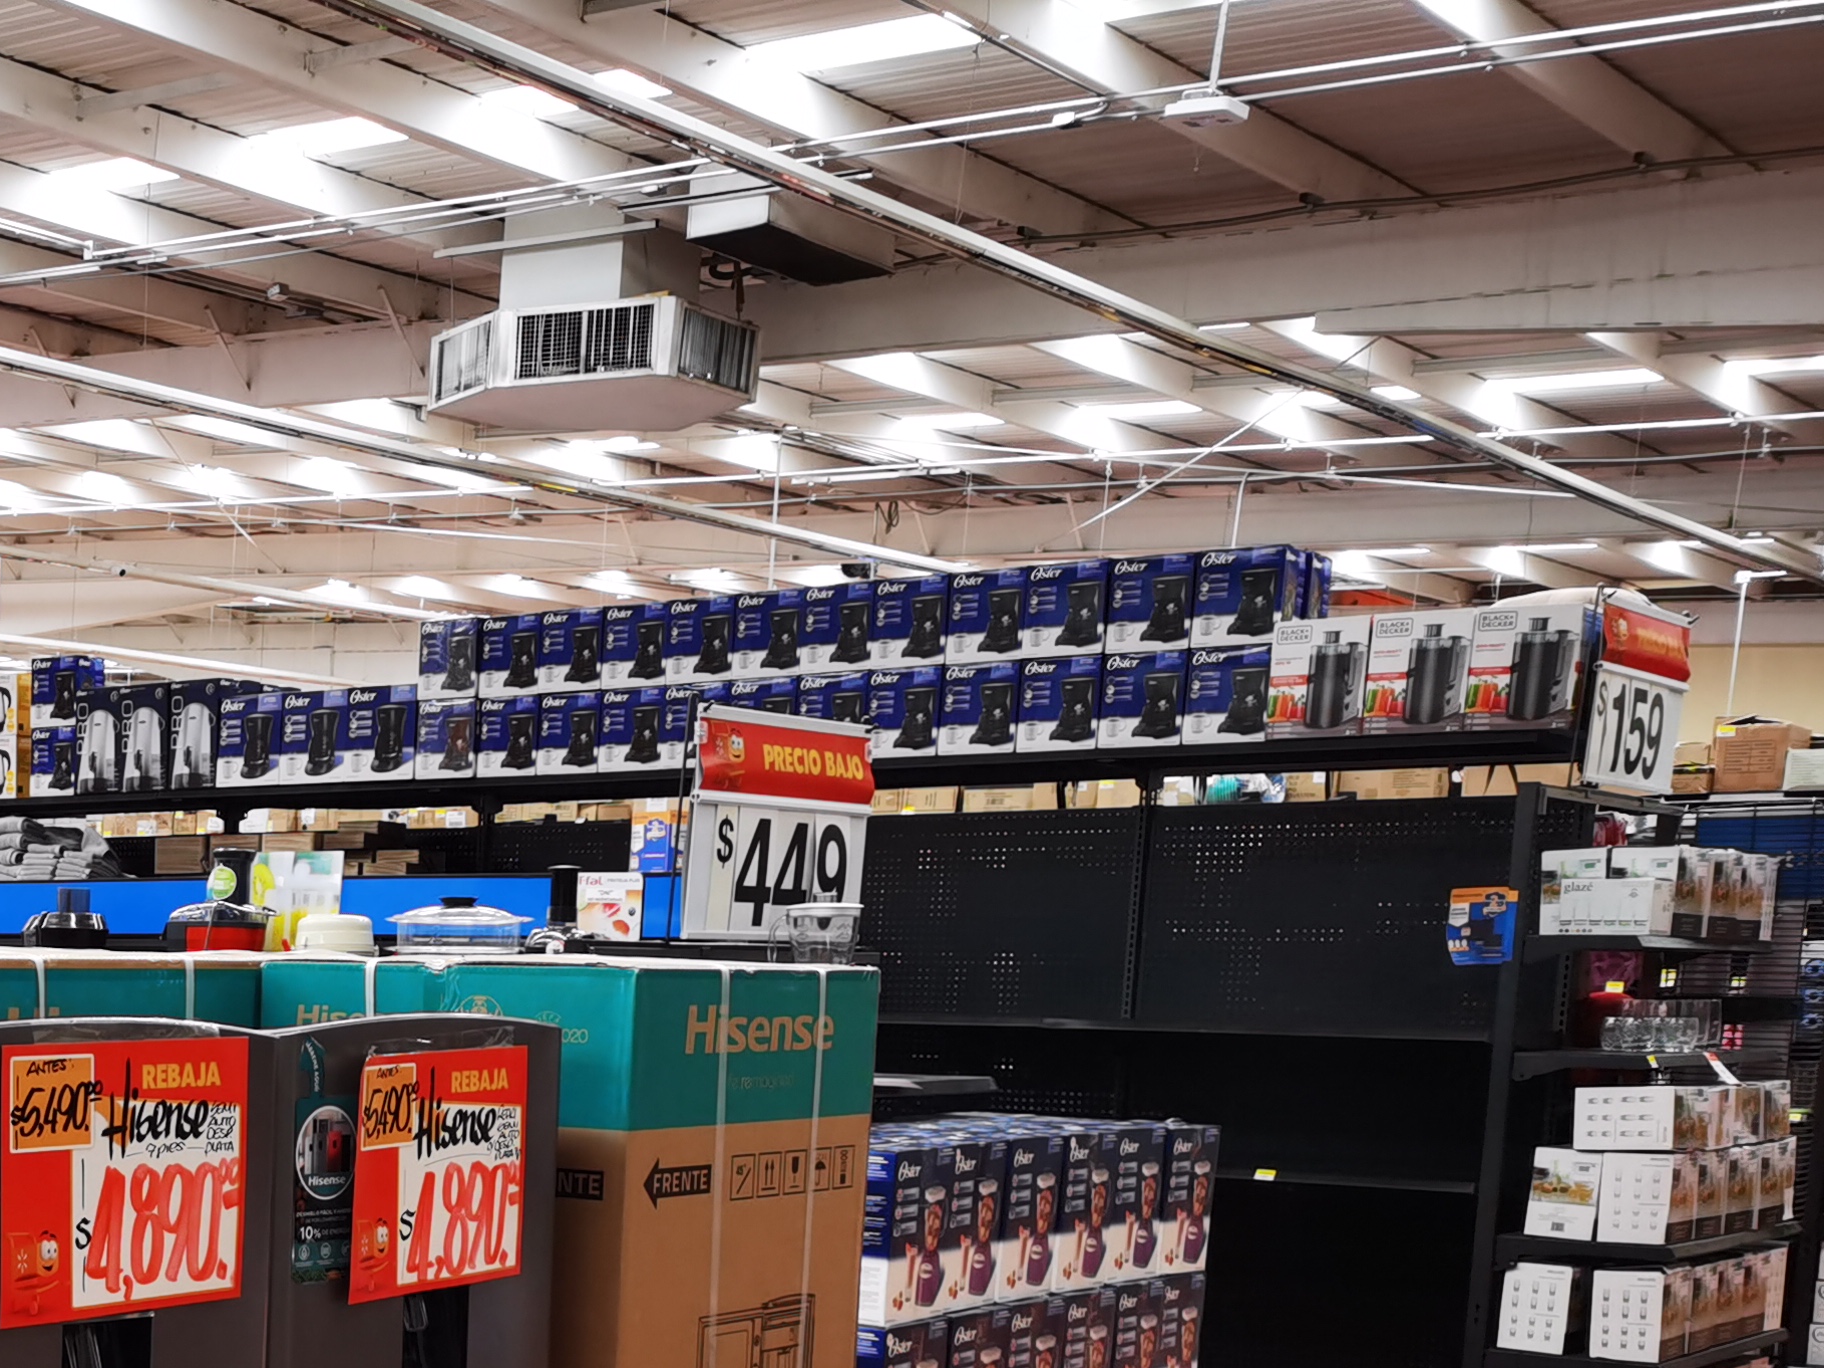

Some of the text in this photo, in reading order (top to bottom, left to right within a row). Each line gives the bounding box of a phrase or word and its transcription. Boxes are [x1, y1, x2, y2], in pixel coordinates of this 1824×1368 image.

[1114, 559, 1149, 576] Oster
[1200, 551, 1236, 569] Oster
[953, 573, 985, 589] Oster
[1030, 566, 1063, 582] Oster
[806, 586, 835, 602] Oster
[877, 581, 907, 597] Oster
[671, 601, 699, 616] Oster
[737, 593, 766, 609] Oster
[542, 611, 569, 627] Oster
[606, 606, 633, 622] Oster
[421, 622, 445, 636] Oster
[482, 618, 508, 633] Oster
[1379, 627, 1411, 636] DECKER
[1481, 620, 1515, 630] DECKER
[1280, 634, 1309, 643] DECKER
[32, 657, 52, 671] Oster
[1106, 655, 1140, 671] Oster
[1192, 649, 1227, 667] Oster
[946, 665, 976, 681] Oster
[1025, 660, 1057, 677] Oster
[800, 676, 828, 691] Oster
[870, 671, 900, 687] Oster
[731, 680, 759, 696] Oster
[284, 694, 312, 710] Oster
[349, 688, 378, 706] Oster
[542, 694, 567, 710] Oster
[603, 690, 630, 705] Oster
[220, 698, 247, 715] Oster
[481, 698, 506, 714] Oster
[762, 743, 865, 782] PRECIO BAJO
[1563, 880, 1594, 894] glazé
[684, 1004, 835, 1055] Hisense
[141, 1061, 222, 1090] REBAJA
[451, 1067, 509, 1094] REBAJA
[101, 1057, 209, 1160] Hisense
[412, 1066, 497, 1161] Hisense
[307, 1174, 347, 1187] Hisense
[652, 1168, 708, 1195] FRENTE
[299, 1226, 322, 1241] 10%
